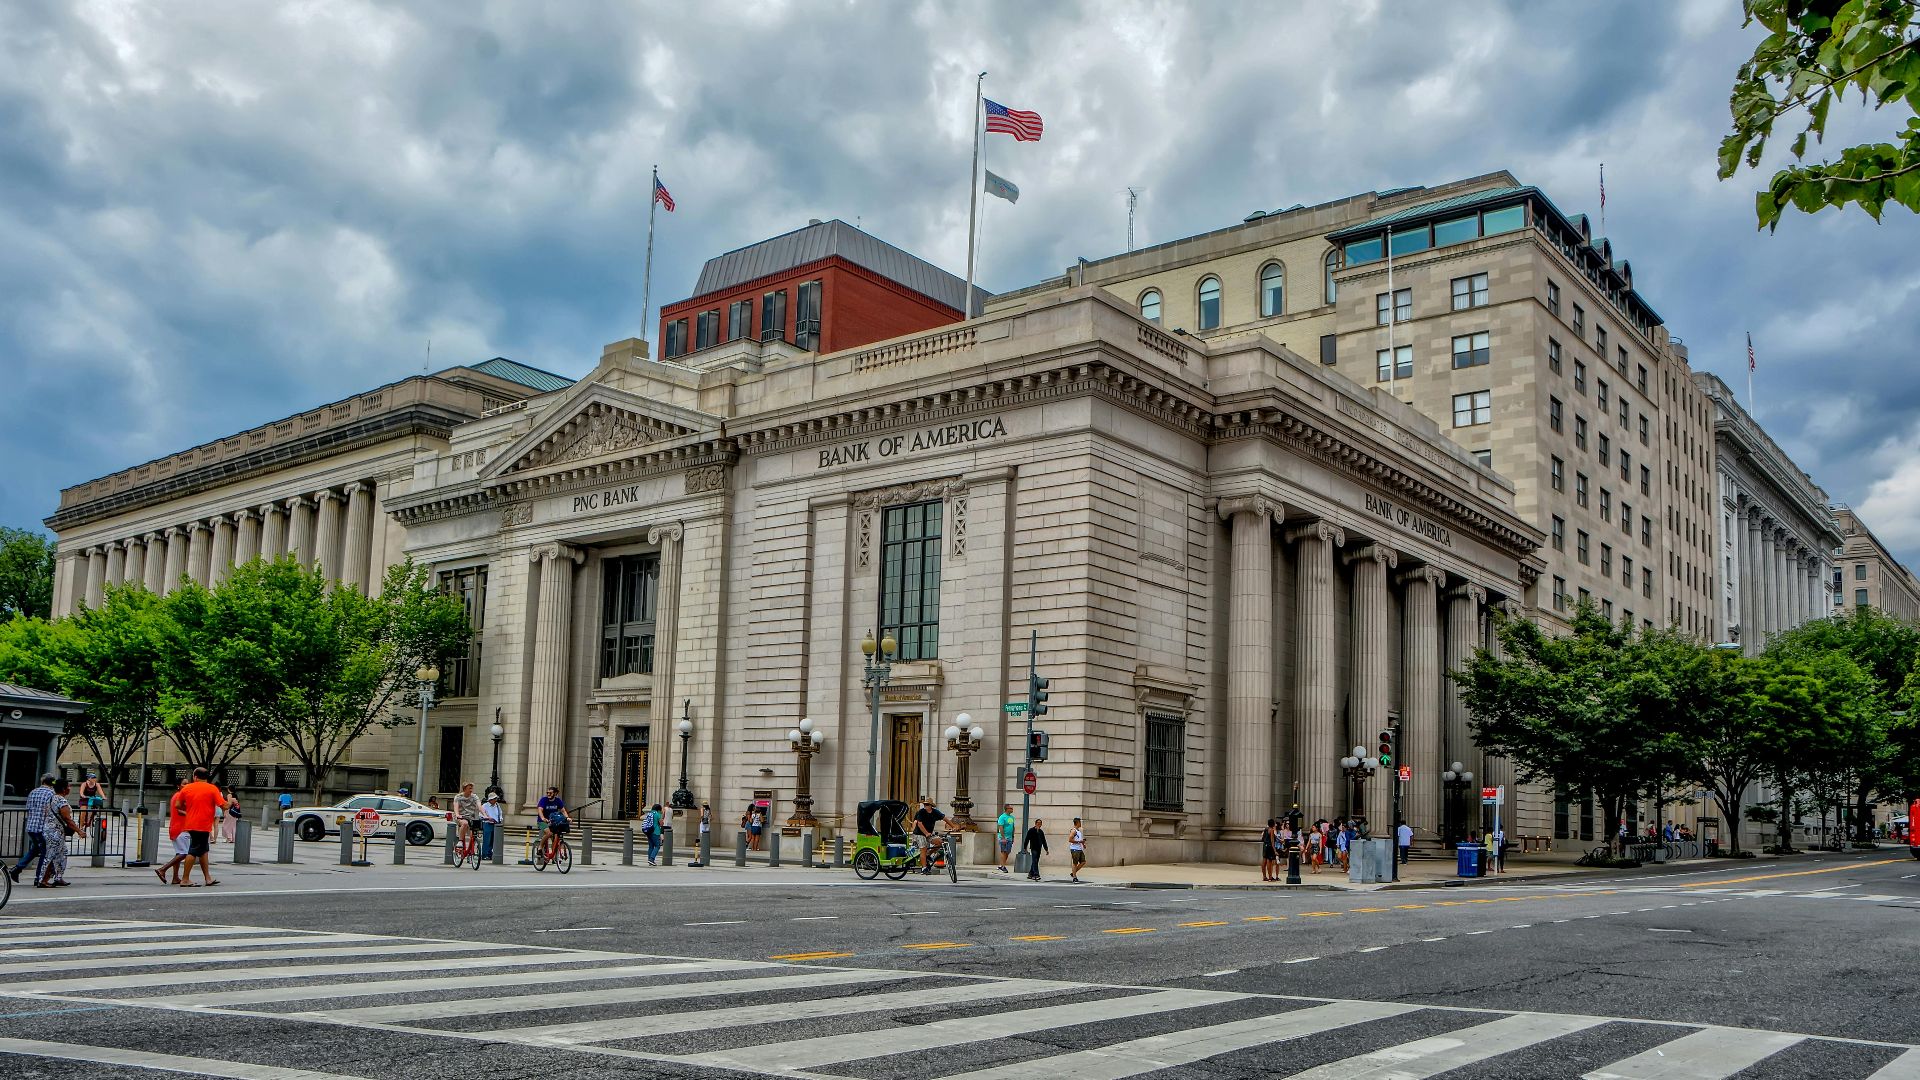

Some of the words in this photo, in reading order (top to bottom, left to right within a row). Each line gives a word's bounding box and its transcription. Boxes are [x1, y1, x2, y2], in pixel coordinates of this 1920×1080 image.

[818, 442, 870, 469] BANK
[878, 436, 904, 457] OF
[910, 416, 1007, 453] AMERICA
[573, 494, 598, 512] PNC
[603, 486, 639, 507] BANK
[1365, 493, 1393, 521] BANK
[1397, 509, 1409, 527] OF
[1411, 516, 1452, 547] AMERICA
